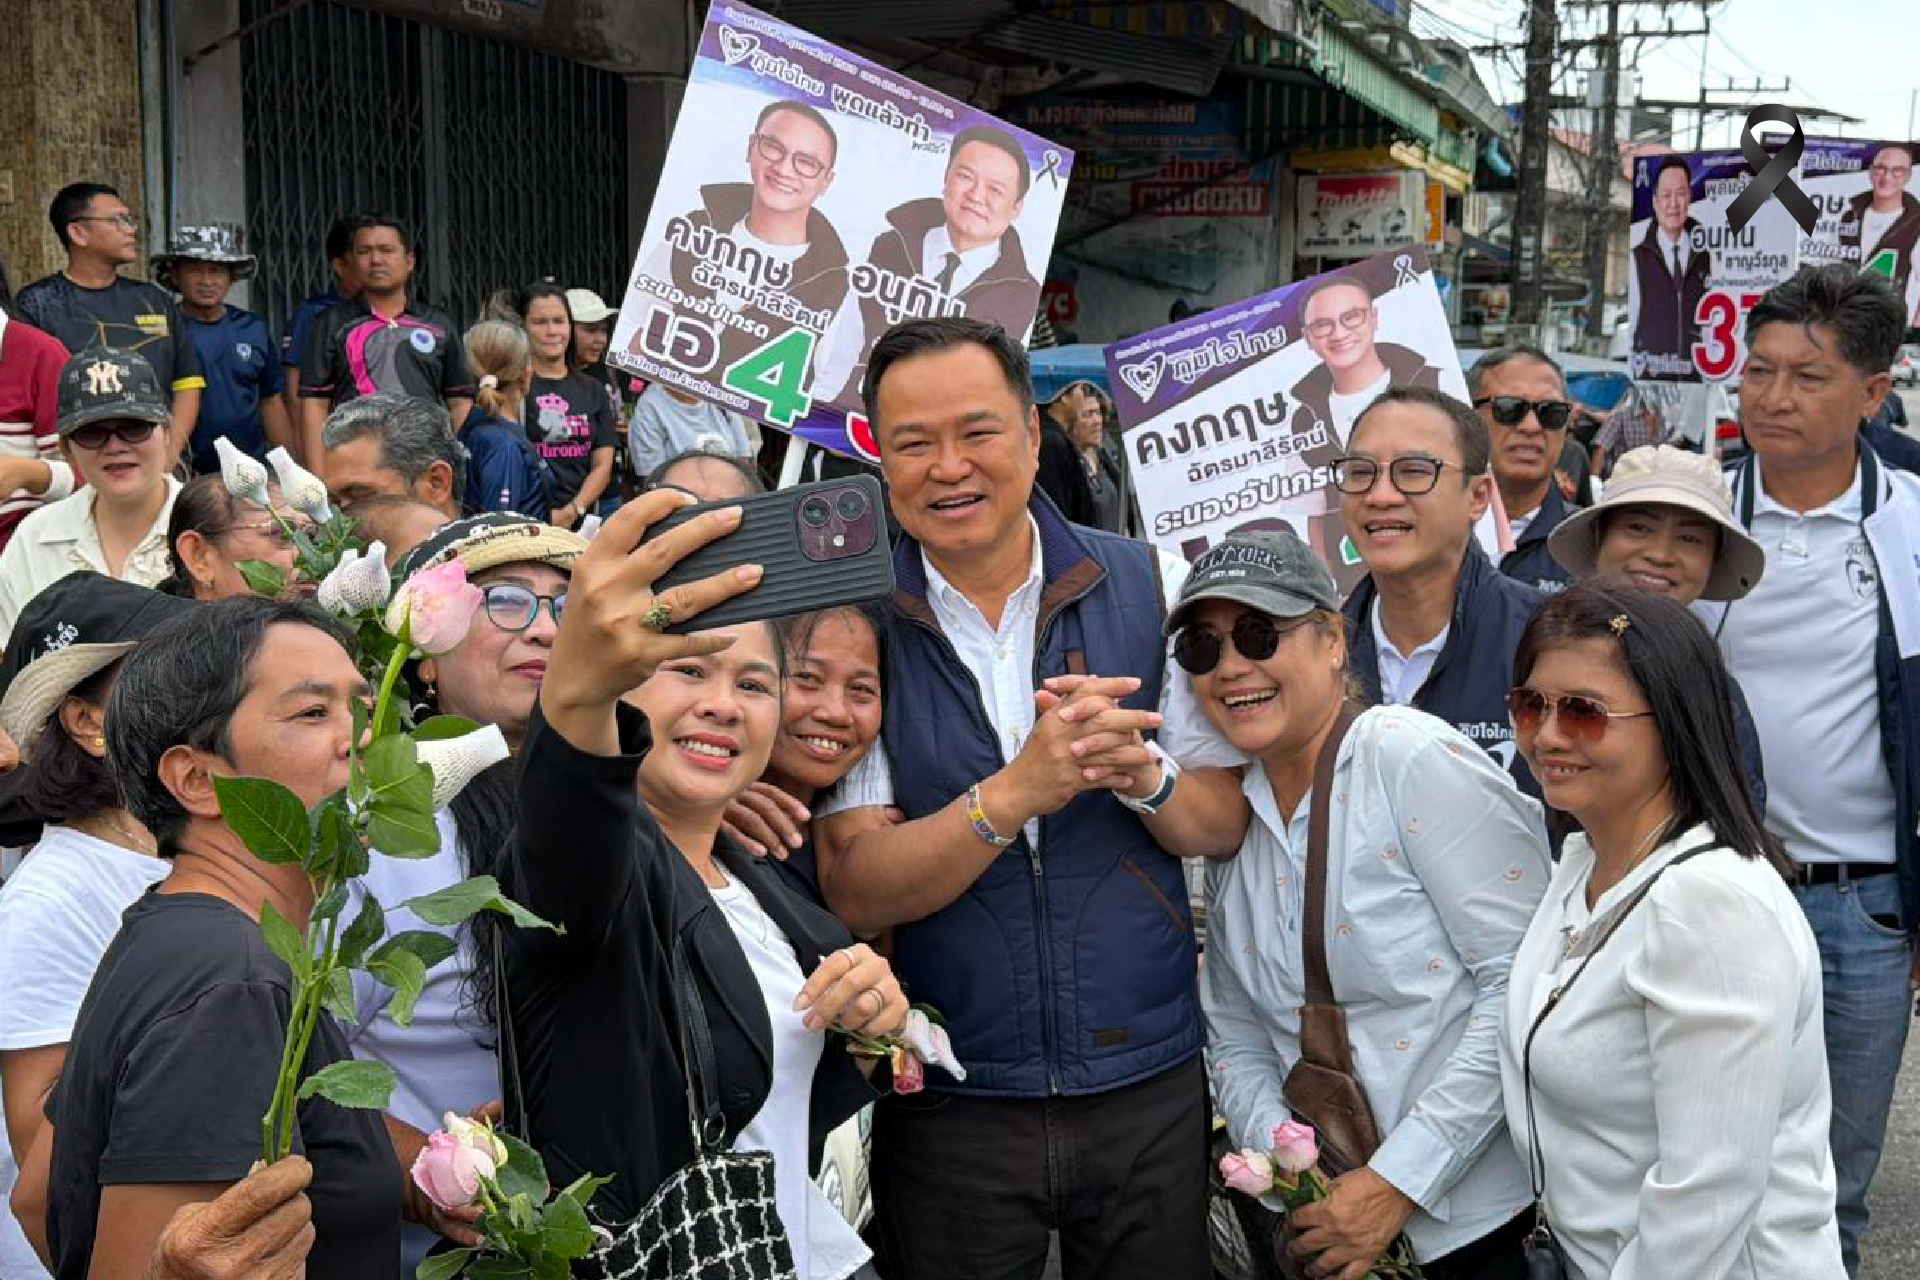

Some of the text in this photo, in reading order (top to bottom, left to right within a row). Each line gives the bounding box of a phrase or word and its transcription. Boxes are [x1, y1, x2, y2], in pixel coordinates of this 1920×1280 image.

[831, 83, 933, 142] พูดแล้วทำ
[664, 216, 791, 289] คงกฤษ
[635, 274, 770, 340] ระนองอัปเกรด
[693, 260, 832, 333] ฉัตรมาลีรัตน์
[1167, 325, 1288, 384] ภูมิใจไทย
[1691, 290, 1763, 380] 3
[722, 326, 816, 428] 4
[1136, 391, 1289, 466] คงกฤษ
[1187, 420, 1327, 483] ฉัตรมาลีรัตน์
[1231, 545, 1284, 577] YORK
